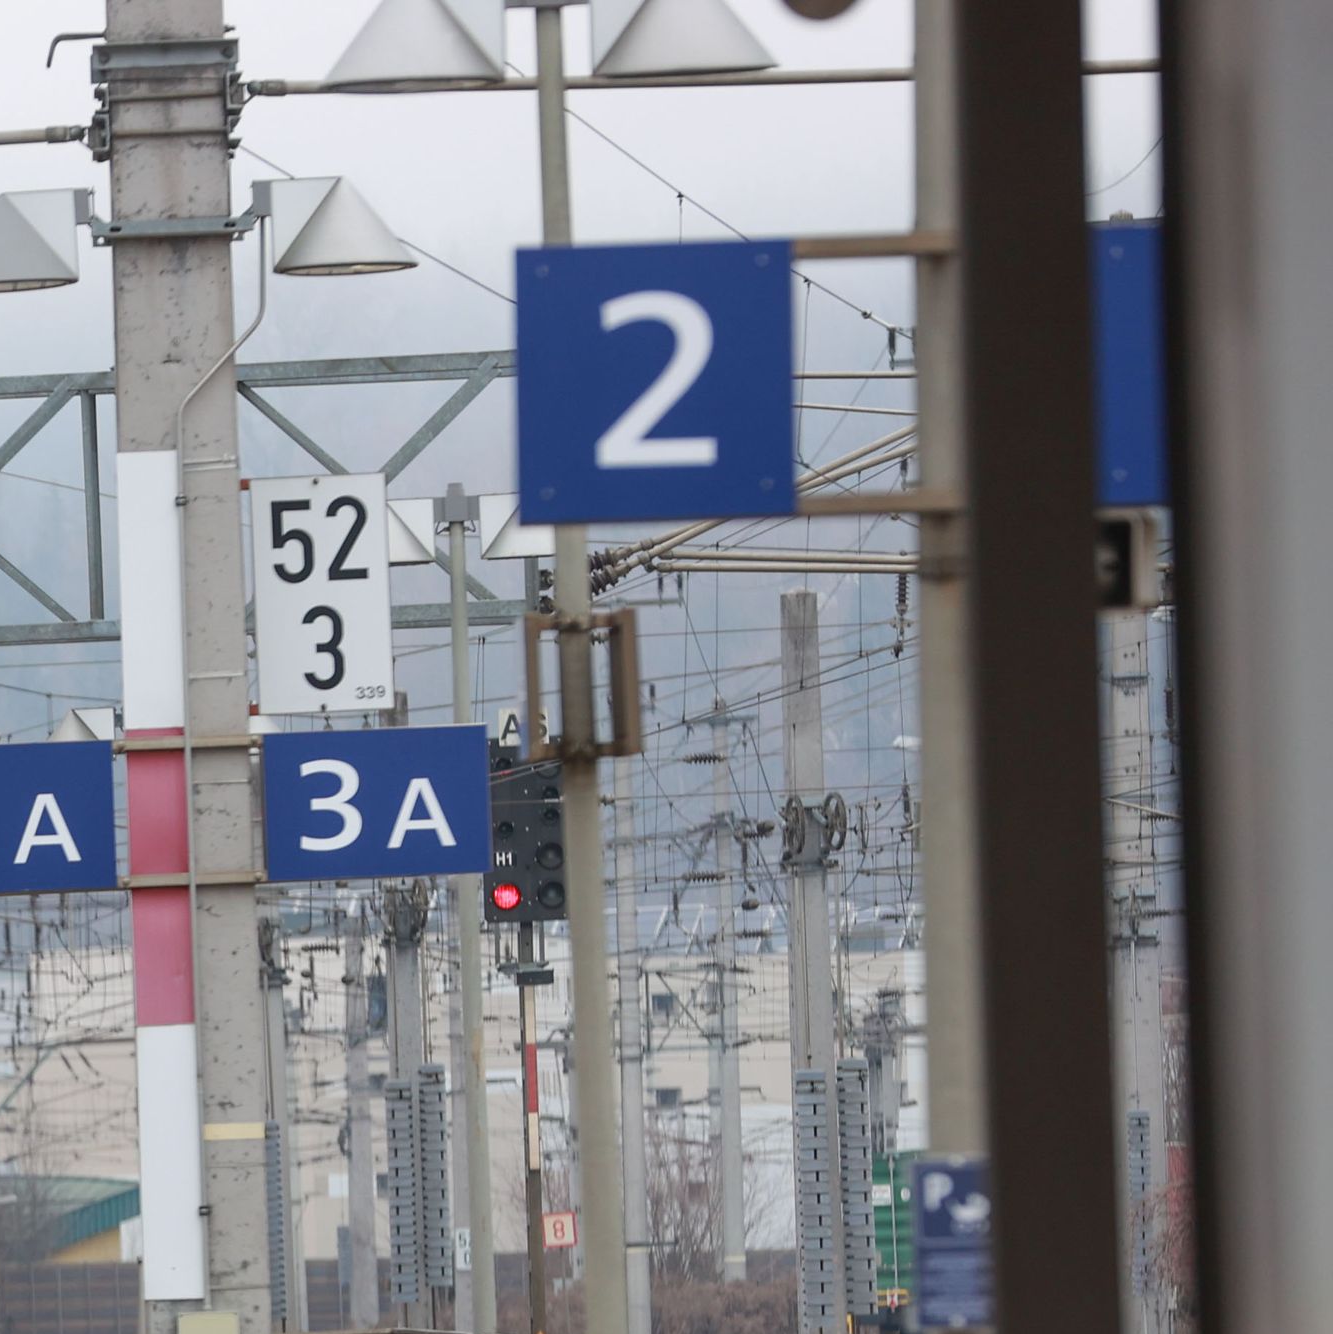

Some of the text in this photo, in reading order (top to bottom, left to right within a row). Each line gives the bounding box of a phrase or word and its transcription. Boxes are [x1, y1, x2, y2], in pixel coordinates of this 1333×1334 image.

[594, 288, 719, 470] 2
[270, 494, 369, 584] 52
[301, 604, 346, 691] 3
[355, 684, 386, 700] 339
[13, 792, 83, 865] A
[299, 758, 458, 852] 3 A
[495, 851, 514, 867] H1
[552, 1218, 566, 1241] 8
